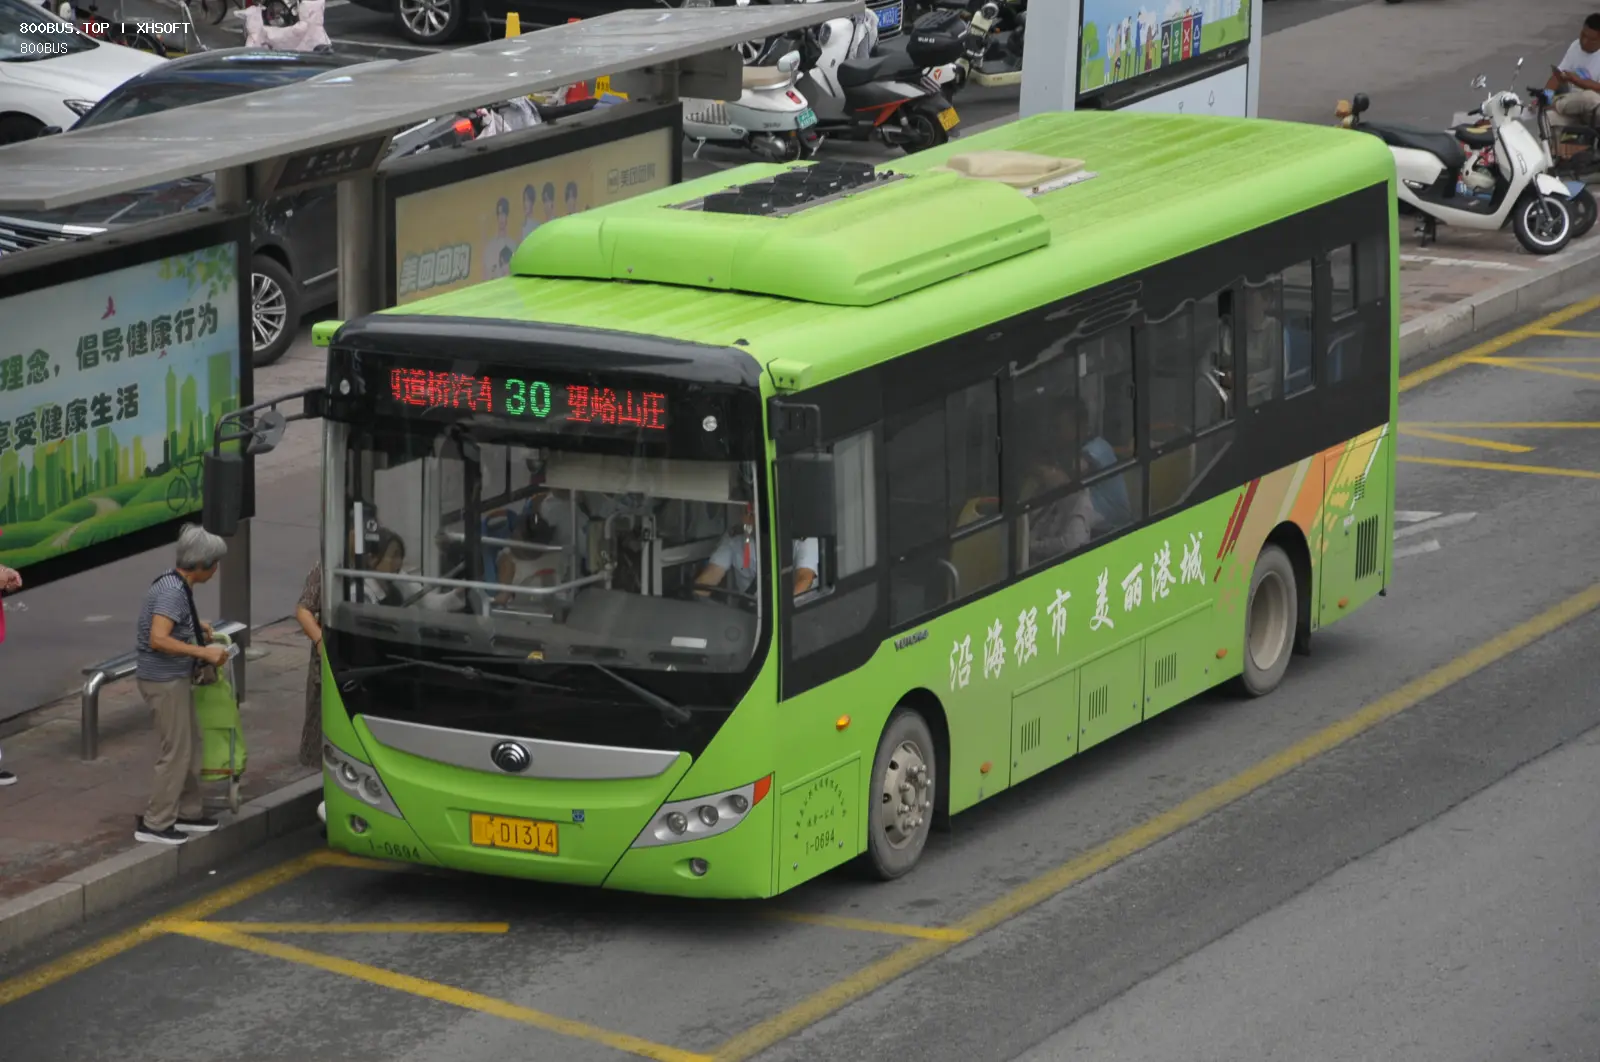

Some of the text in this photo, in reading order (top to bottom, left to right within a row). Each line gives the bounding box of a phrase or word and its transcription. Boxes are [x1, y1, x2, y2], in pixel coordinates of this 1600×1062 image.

[399, 244, 471, 297] 美团团购
[505, 378, 552, 418] 30
[950, 531, 1206, 692] 沿海强市 美丽港城
[806, 829, 835, 855] 1-0694
